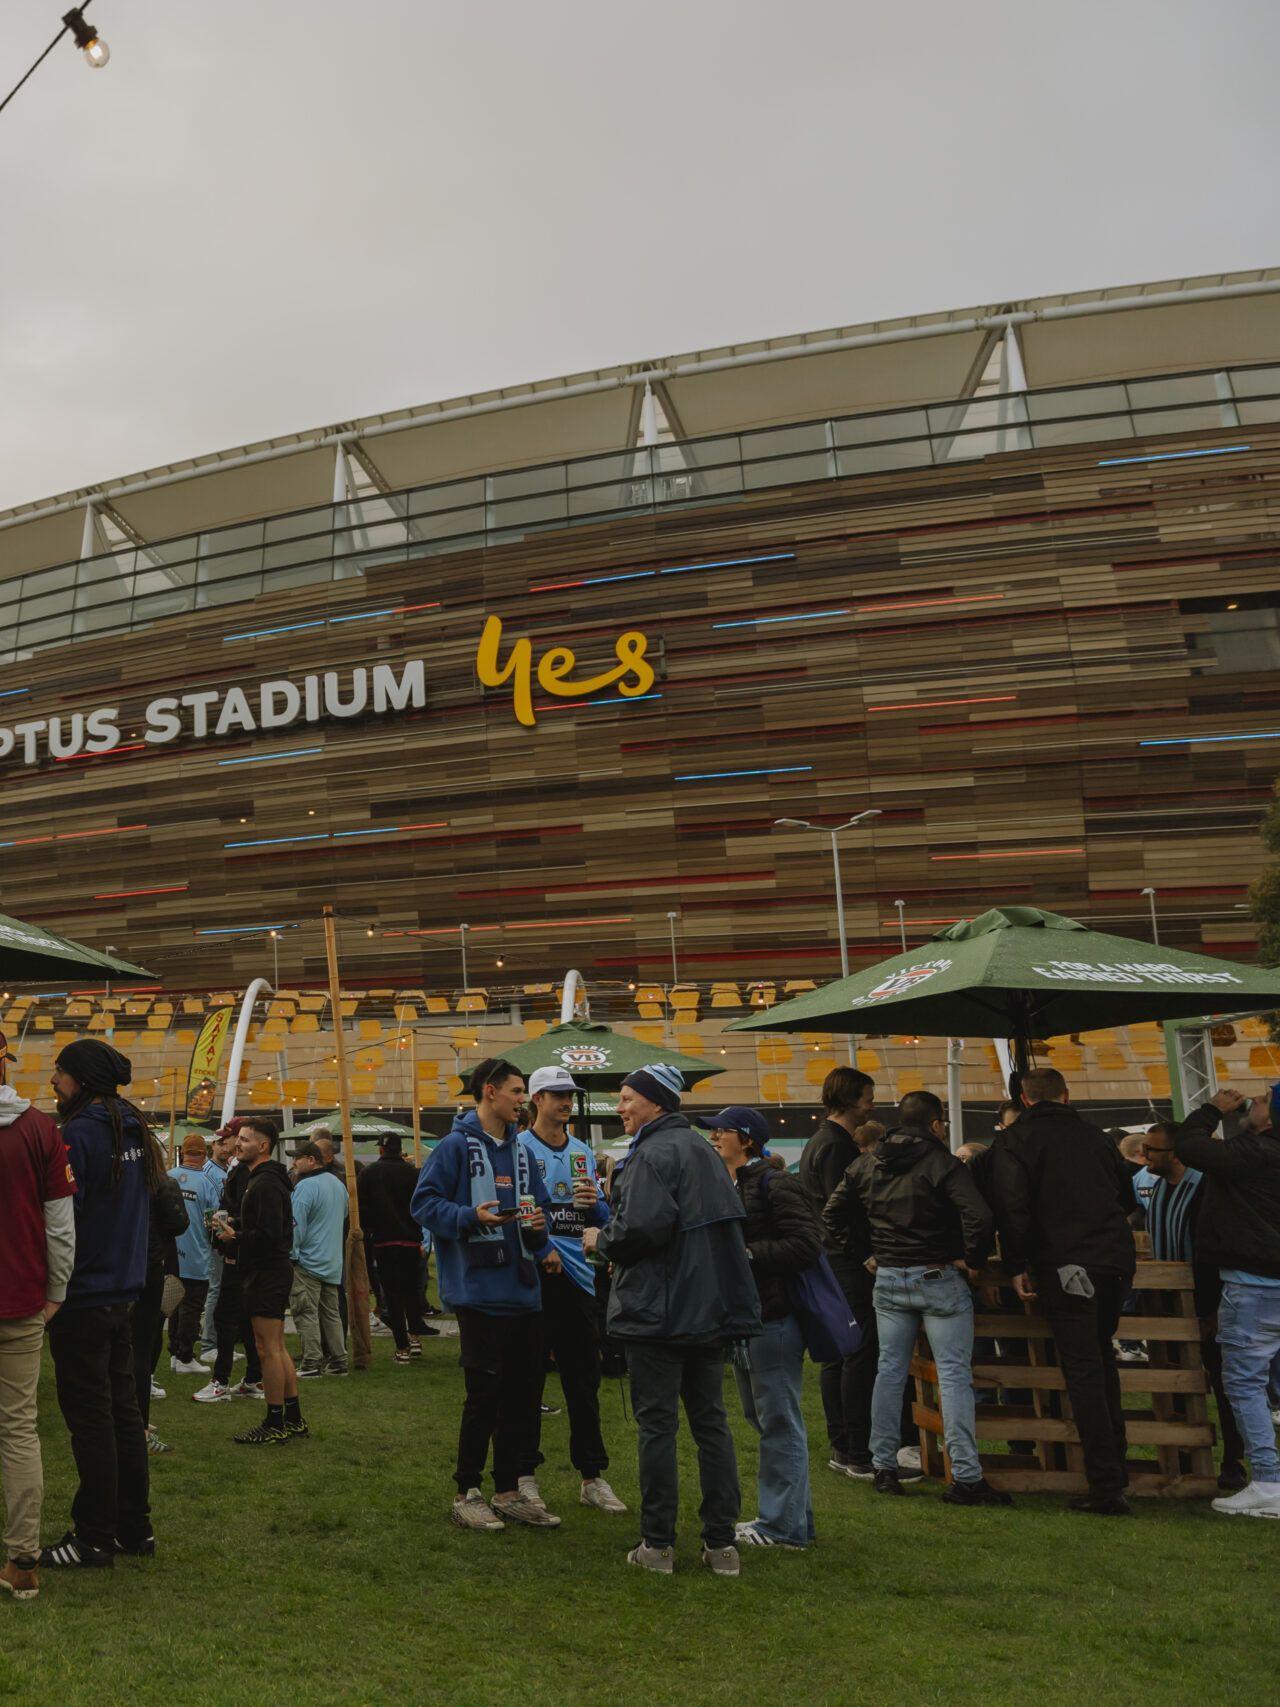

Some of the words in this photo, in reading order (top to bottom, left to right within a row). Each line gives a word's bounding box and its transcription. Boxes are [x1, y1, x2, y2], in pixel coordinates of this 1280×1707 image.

[476, 614, 656, 727] yes
[144, 659, 426, 744] STADIUM
[1031, 966, 1144, 984] EARNED
[1136, 972, 1244, 984] THIRST
[1048, 960, 1095, 972] FOR
[1097, 962, 1114, 973] A
[1115, 963, 1184, 974] HARD
[206, 1012, 224, 1068] SATAY
[552, 1045, 612, 1055] VICTORIA
[567, 1054, 602, 1062] VB
[560, 1062, 614, 1071] BITTER
